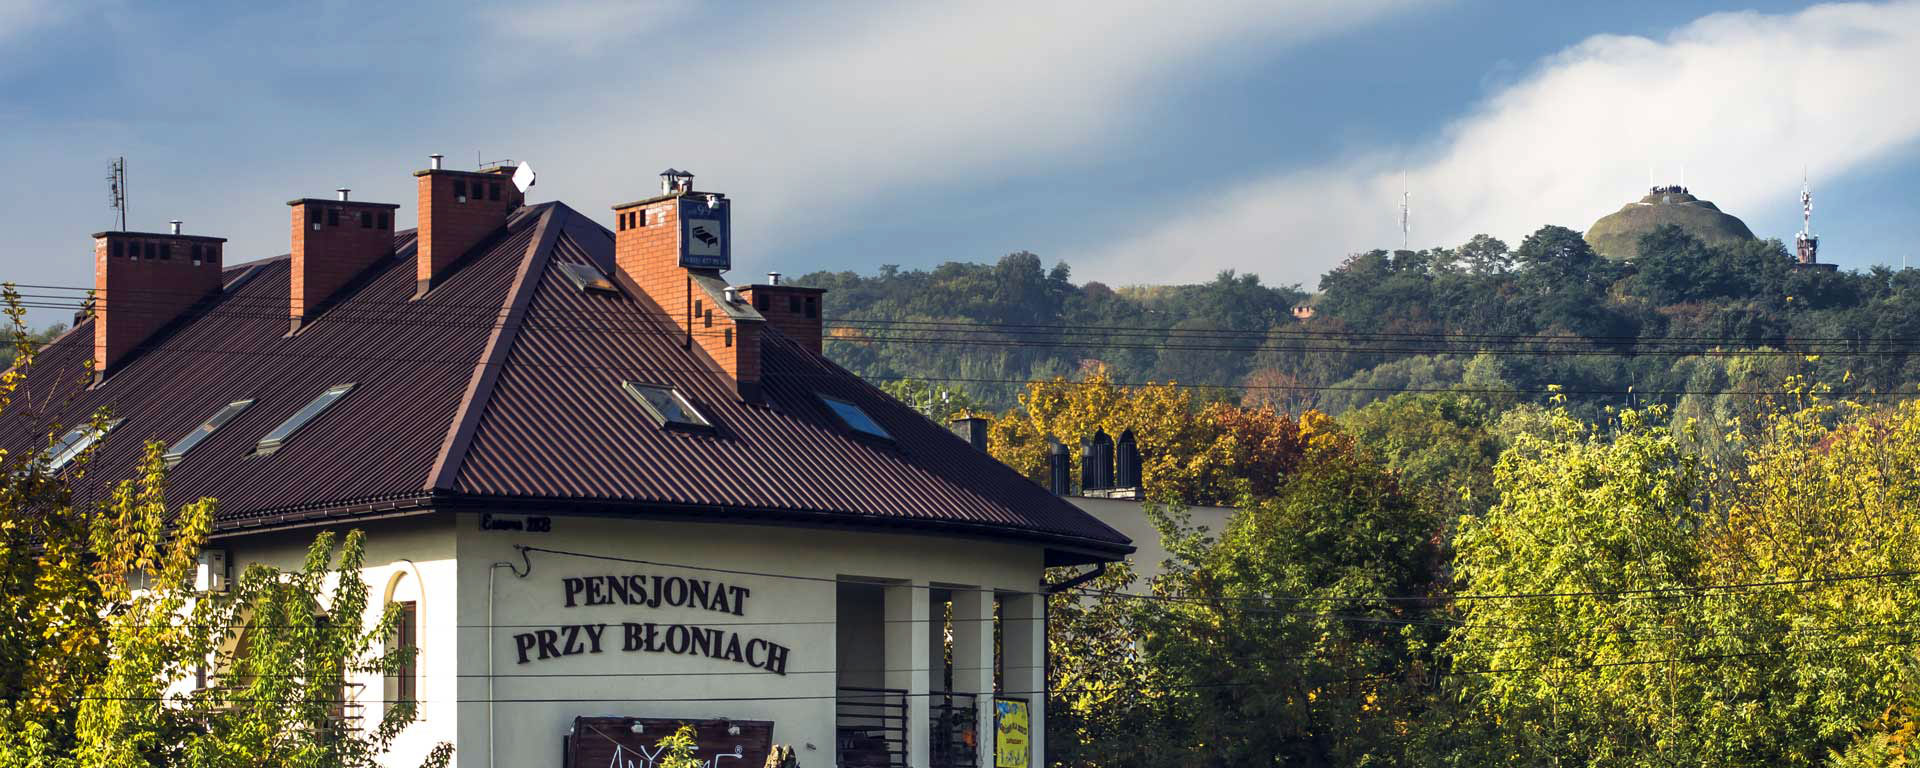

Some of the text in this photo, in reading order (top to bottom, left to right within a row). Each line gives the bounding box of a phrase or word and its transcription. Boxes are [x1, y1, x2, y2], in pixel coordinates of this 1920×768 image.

[563, 575, 750, 616] PENSJONAT
[514, 622, 791, 676] PRZY BŁONIACH
